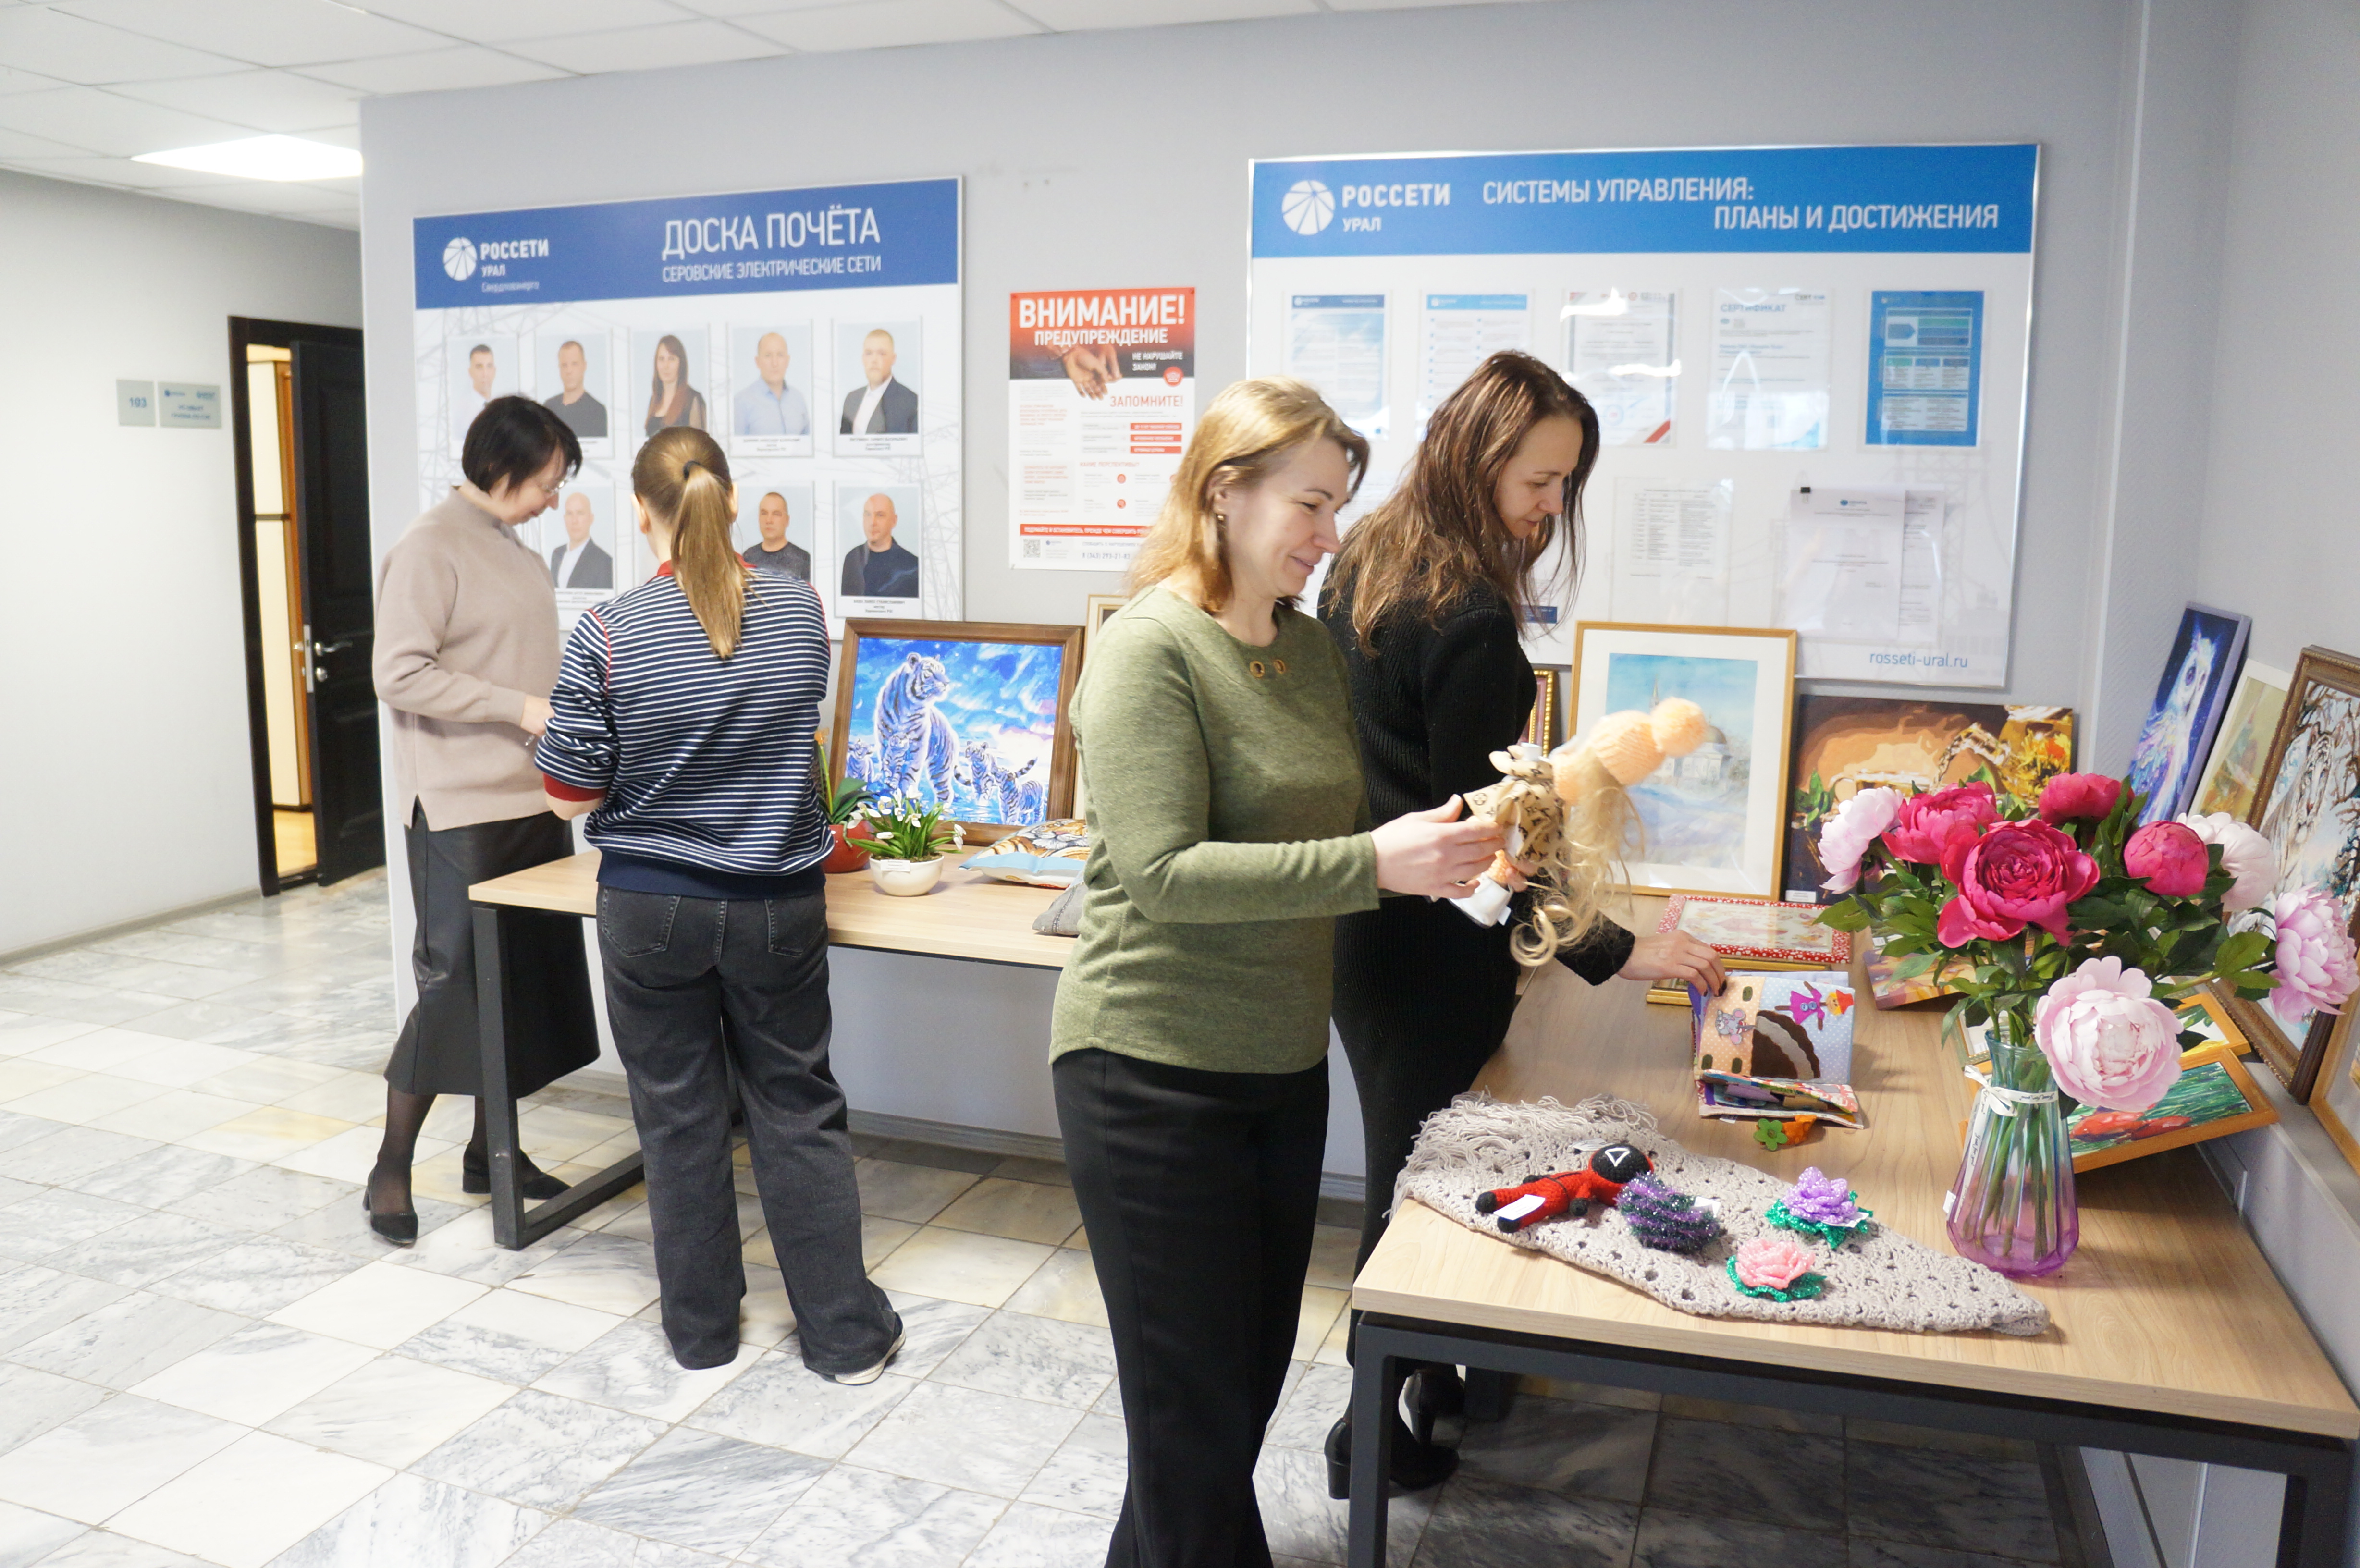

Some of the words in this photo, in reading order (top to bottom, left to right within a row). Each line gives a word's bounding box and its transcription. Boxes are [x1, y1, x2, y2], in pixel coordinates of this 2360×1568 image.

[1342, 184, 1450, 208] РОССЕТИ
[1483, 180, 1590, 204] СИСТЕМЫ
[1597, 177, 1754, 202] УПРАВЛЕНИЯ:
[1342, 217, 1381, 232] УРАЛ
[1714, 206, 1798, 230] ПЛАНЫ
[1806, 205, 1823, 229] И
[1827, 205, 1999, 233] ДОСТИЖЕНИЯ
[662, 215, 759, 261] ДОСКА
[767, 204, 881, 249] ПОЧЁТА
[480, 239, 549, 260] РОССЕТИ
[482, 264, 506, 277] УРАЛ
[662, 261, 733, 282] СЕРОВСКИЕ
[736, 256, 845, 278] ЭЛЕКТРИЧЕСКИЕ
[847, 255, 881, 273] СЕТИ
[1019, 294, 1185, 328] ВНИМАНИЕ!
[1034, 328, 1168, 346] ПРЕДУПРЕЖДЕНИЕ
[1132, 352, 1142, 360] НЕ
[1110, 395, 1183, 407] ЗАПОМНИТЕ!
[1869, 652, 1968, 668] rosseti-ural.ru
